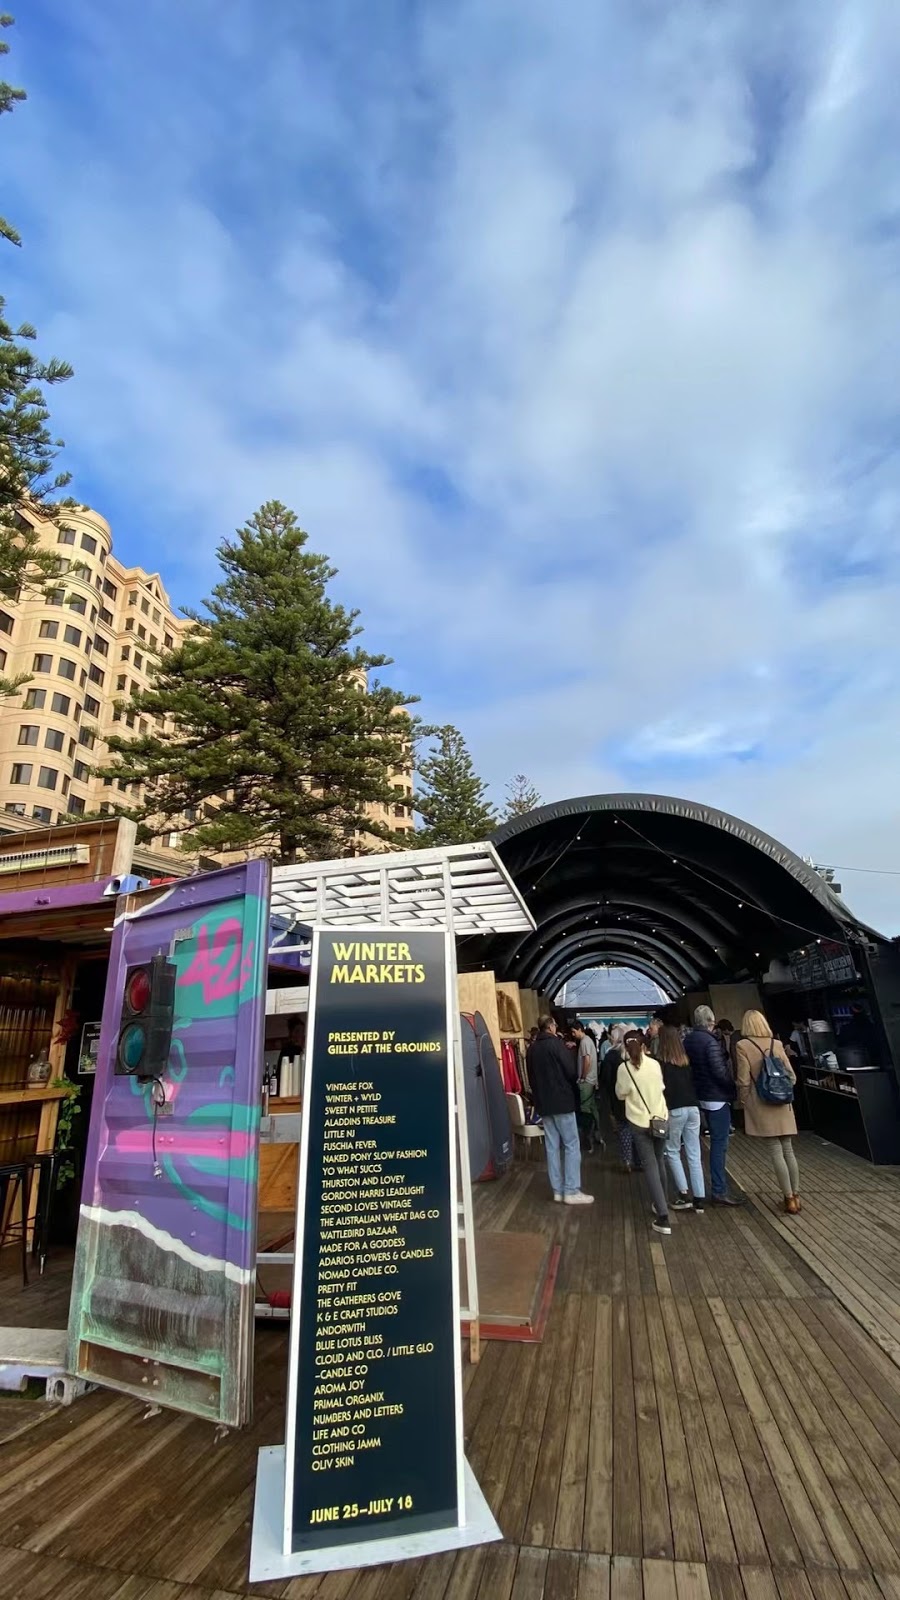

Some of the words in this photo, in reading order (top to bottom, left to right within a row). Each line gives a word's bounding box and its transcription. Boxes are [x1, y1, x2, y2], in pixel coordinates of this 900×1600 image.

[332, 943, 412, 960] WINTER
[330, 964, 425, 983] MARKETS
[328, 1032, 379, 1042] PRESENTED
[383, 1031, 395, 1040] BY
[328, 1044, 358, 1055] GILLES
[361, 1044, 372, 1054] AT
[375, 1043, 392, 1053] THE
[394, 1042, 440, 1052] GROUNDS
[326, 1083, 357, 1091] VINTAGE
[358, 1082, 373, 1090] FOX
[325, 1095, 352, 1103] WINTER
[361, 1093, 381, 1101] WYLD
[325, 1106, 348, 1115] SWEET
[357, 1105, 378, 1113] PETITE
[324, 1118, 361, 1127] ALADDINS
[363, 1116, 396, 1124] TREASURE
[324, 1130, 344, 1139] LITTLE
[323, 1142, 353, 1151] FUSCHIA
[355, 1141, 377, 1149] FEVER
[323, 1154, 349, 1163] NAKED
[351, 1153, 371, 1161] PONY
[373, 1151, 395, 1160] SLOW
[396, 1150, 427, 1158] FASHION
[322, 1167, 335, 1176] YO
[337, 1166, 358, 1174] WHAT
[360, 1164, 382, 1173] SUCCS
[322, 1179, 360, 1188] THURSTON
[362, 1177, 378, 1185] AND
[380, 1175, 405, 1184] LOVEY
[321, 1191, 357, 1201] GORDON
[360, 1189, 385, 1198] HARRIS
[386, 1186, 425, 1196] LEADLIGHT
[321, 1204, 352, 1214] SECOND
[355, 1202, 378, 1211] LOVES
[380, 1199, 412, 1209] VINTAGE
[320, 1219, 334, 1227] THE
[335, 1215, 380, 1225] AUSTRALIAN
[383, 1212, 408, 1221] WHEAT
[410, 1211, 425, 1219] BAG
[427, 1210, 439, 1218] CO
[320, 1229, 365, 1239] WATTLEBIRD
[367, 1226, 397, 1235] BAZAAR
[319, 1243, 342, 1253] MADE
[344, 1242, 360, 1251] FOR
[361, 1241, 368, 1249] A
[370, 1238, 405, 1248] GODDESS
[319, 1256, 355, 1267] ADARIOS
[356, 1252, 390, 1263] FLOWERS
[393, 1252, 399, 1260] &
[401, 1248, 433, 1259] CANDLES
[318, 1269, 350, 1280] NOMAD
[352, 1267, 382, 1277] CANDLE
[384, 1265, 399, 1274] CO.
[318, 1283, 344, 1294] PRETTY
[347, 1282, 357, 1291] FIT
[317, 1298, 332, 1308] THE
[333, 1294, 376, 1306] GATHERERS
[378, 1291, 401, 1301] GOVE
[317, 1313, 323, 1322] K
[325, 1312, 331, 1321] &
[333, 1311, 338, 1320] E
[340, 1309, 364, 1319] CRAFT
[366, 1305, 398, 1317] STUDIOS
[316, 1322, 365, 1336] ANDORWITH
[316, 1340, 335, 1351] BLUE
[337, 1337, 362, 1349] LOTUS
[364, 1335, 383, 1345] BLISS
[315, 1354, 344, 1365] CLOUD
[346, 1351, 364, 1362] AND
[366, 1349, 385, 1359] CLO.
[387, 1347, 391, 1357] /
[392, 1345, 414, 1356] LITTLE
[416, 1343, 434, 1354] GLO
[354, 1365, 368, 1375] CO
[314, 1382, 346, 1395] AROMA
[348, 1380, 365, 1391] JOY
[314, 1397, 343, 1410] PRIMAL
[345, 1392, 384, 1406] ORGANIX
[313, 1411, 351, 1425] NUMBERS
[353, 1409, 371, 1420] AND
[374, 1404, 404, 1417] LETTERS
[313, 1429, 328, 1440] LIFE
[330, 1426, 349, 1438] AND
[352, 1425, 365, 1435] CO
[312, 1441, 355, 1456] CLOTHING
[357, 1437, 381, 1450] JAMM
[312, 1459, 333, 1471] OLIV
[335, 1456, 354, 1468] SKIN
[310, 1507, 339, 1524] JUNE
[397, 1495, 413, 1509] 18
